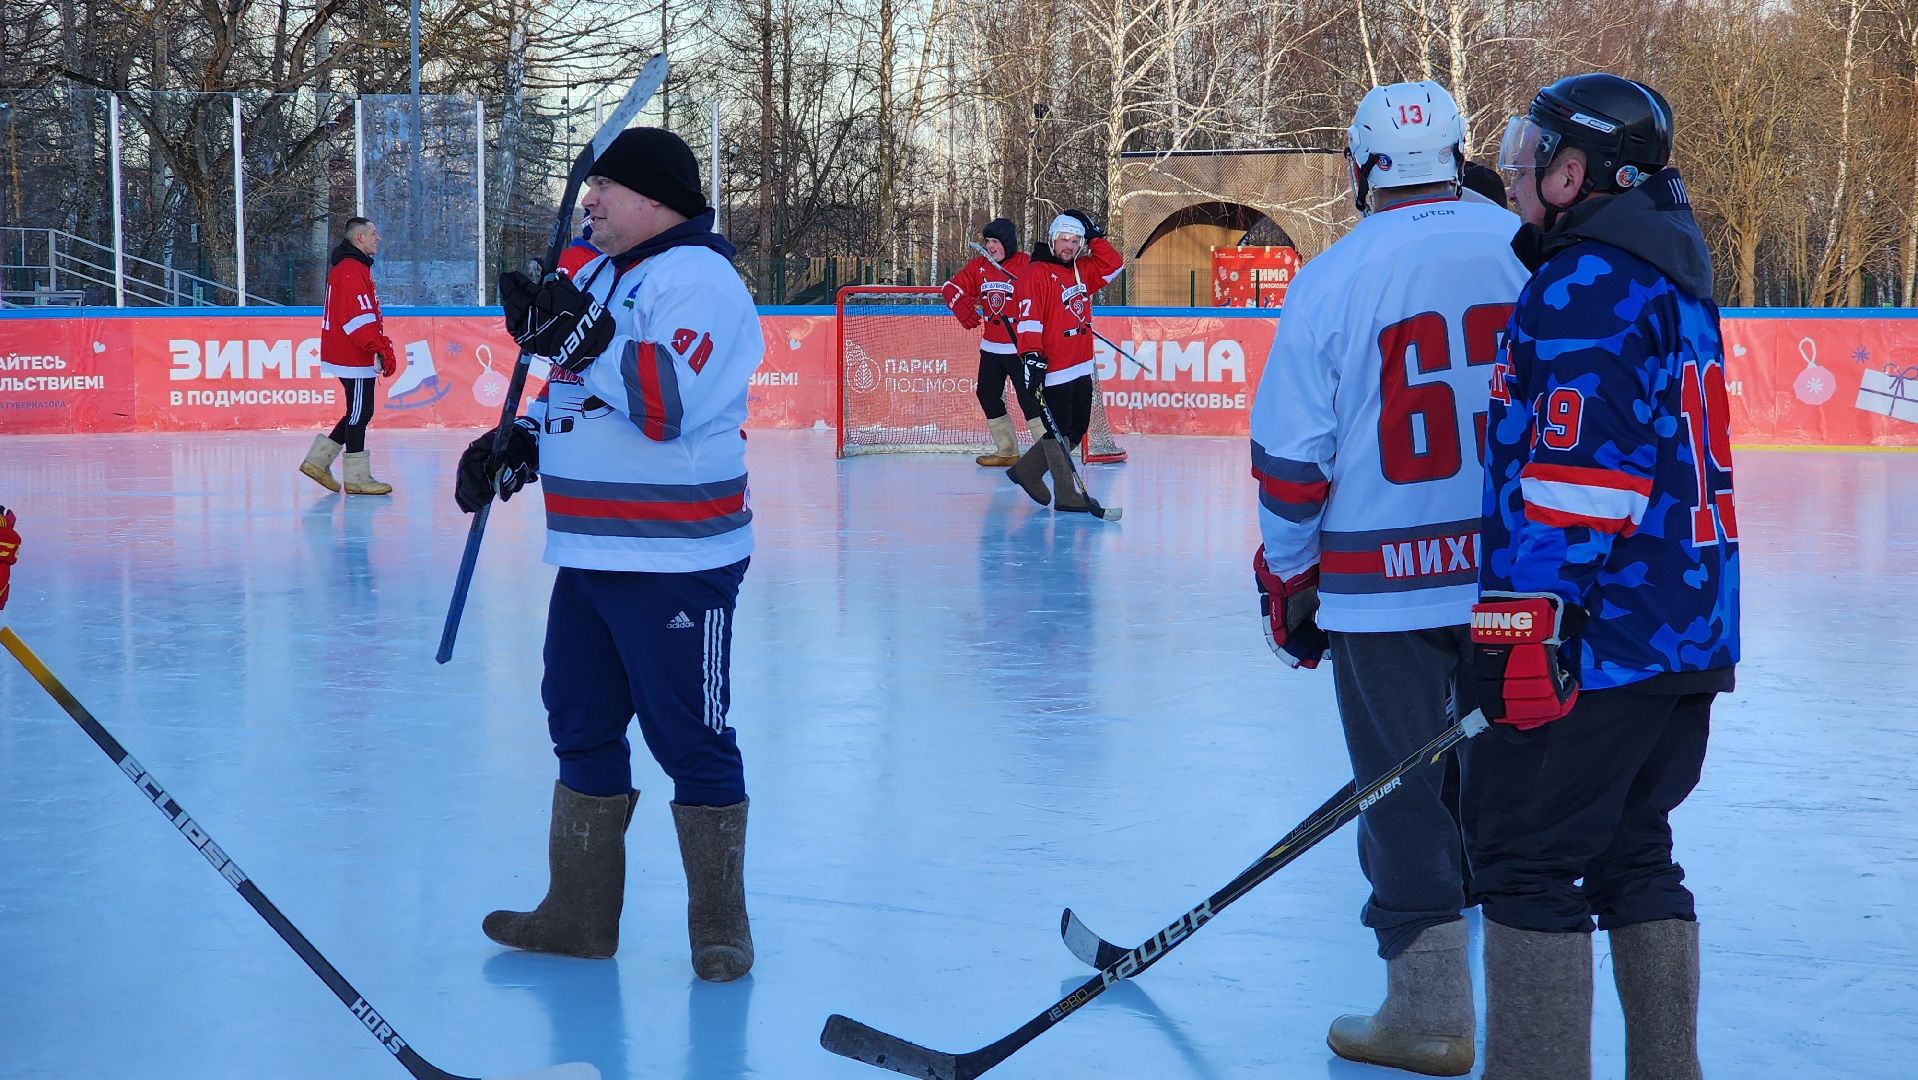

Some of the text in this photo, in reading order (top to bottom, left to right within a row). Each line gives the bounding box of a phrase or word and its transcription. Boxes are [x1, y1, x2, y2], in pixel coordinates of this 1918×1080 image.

[1399, 104, 1424, 125] 13
[1412, 209, 1456, 221] LUTCH
[1250, 268, 1289, 281] ЗИМА
[356, 293, 373, 311] 11
[169, 338, 335, 380] ЗИМА
[885, 359, 948, 374] ПАРКИ
[1092, 339, 1246, 383] ЗИМА
[170, 389, 335, 408] В ПОДМОСКОВЬЕ
[1102, 391, 1246, 410] ПОДМОСКОВЬЕ
[1381, 532, 1480, 580] МИХ
[666, 620, 695, 629] adidas
[1478, 629, 1533, 638] HOCKEY
[118, 753, 249, 890] ECLIPSE
[350, 996, 407, 1056] HORS
